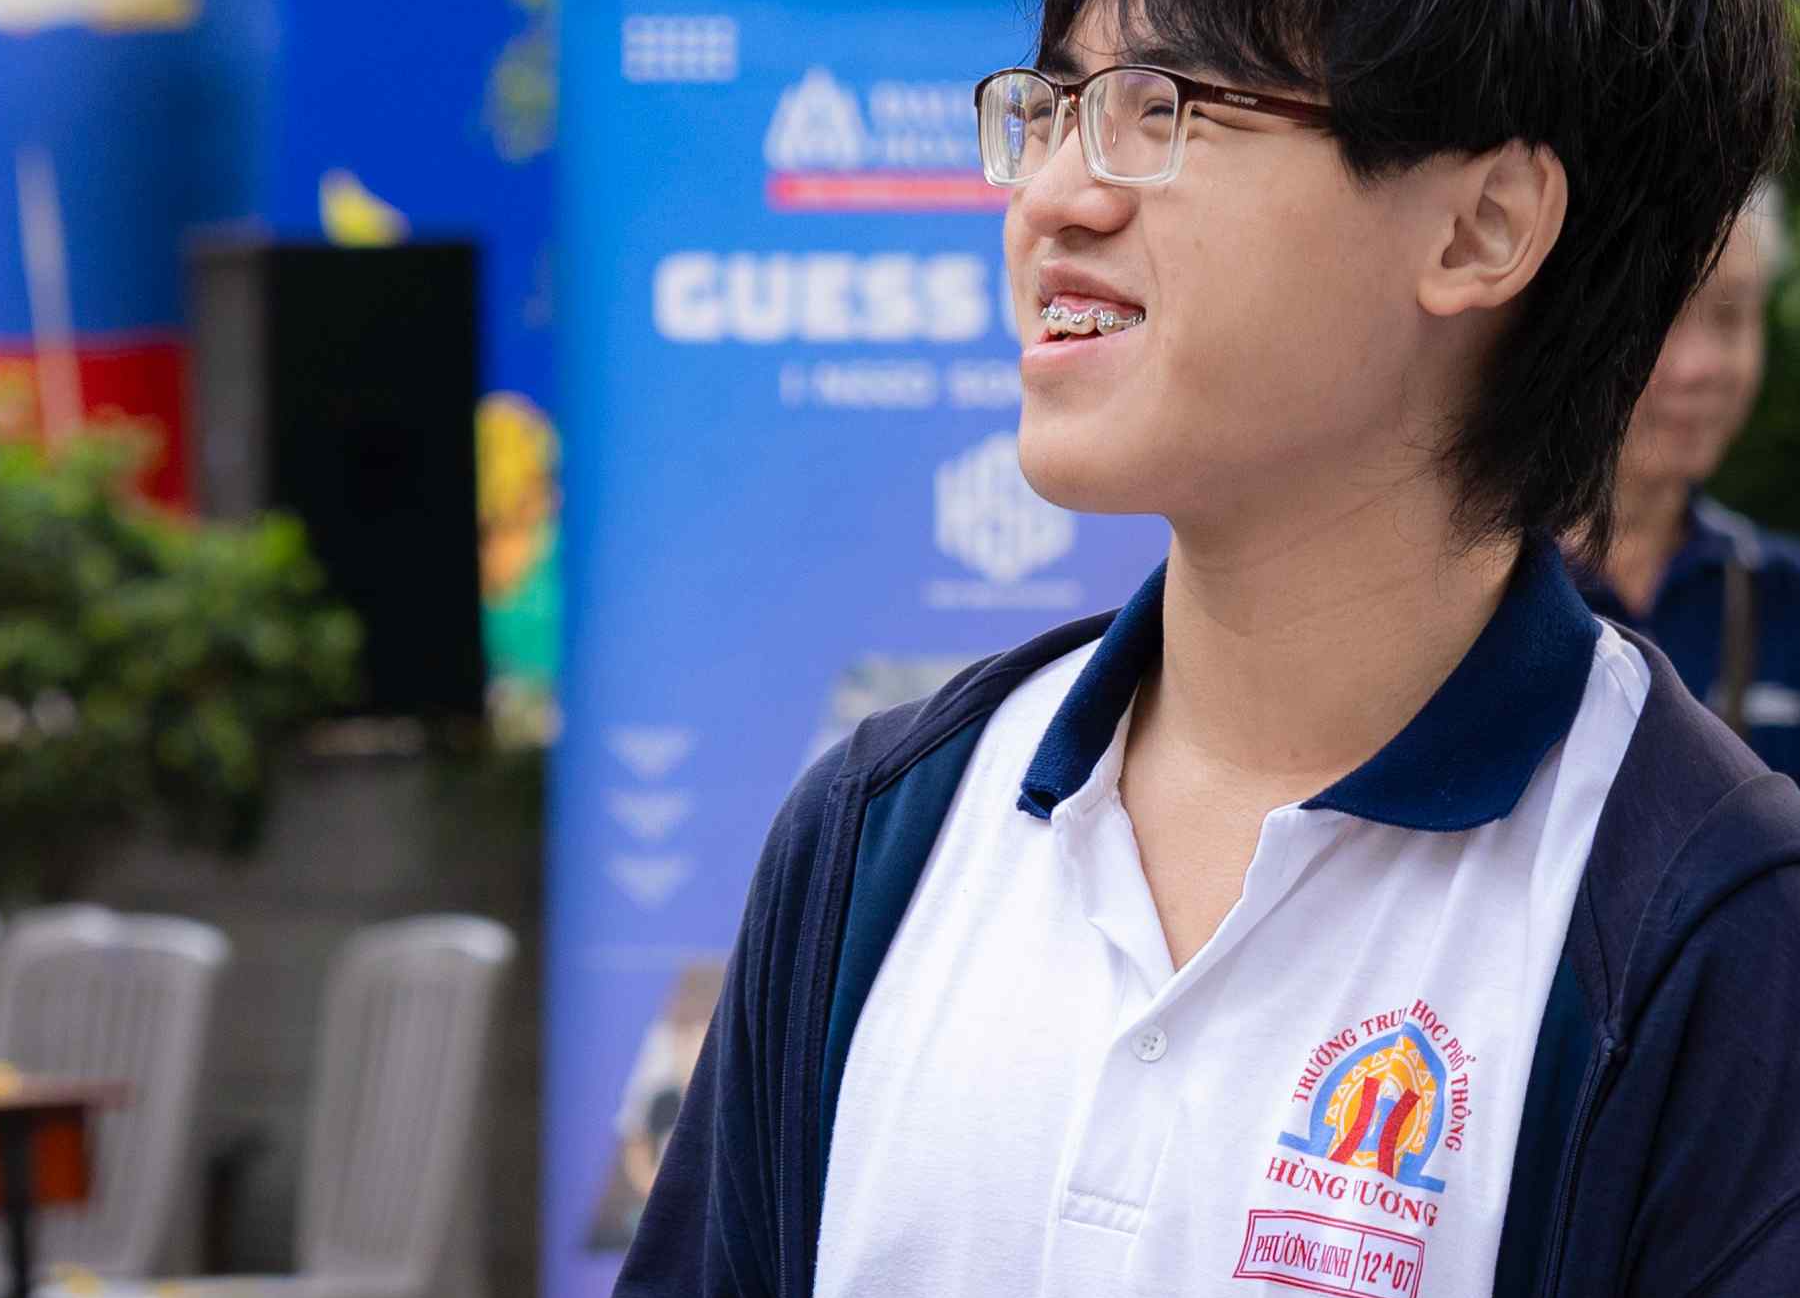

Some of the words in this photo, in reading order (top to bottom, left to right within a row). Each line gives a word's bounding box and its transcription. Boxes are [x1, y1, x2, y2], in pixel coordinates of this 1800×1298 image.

[653, 252, 991, 343] GUESS
[1291, 1028, 1358, 1103] TRƯỜNG
[1409, 999, 1449, 1042] HỌC
[1444, 1073, 1472, 1152] THÔNG
[1265, 1157, 1348, 1200] HÙNG
[1252, 1231, 1320, 1272] PHƯƠNG
